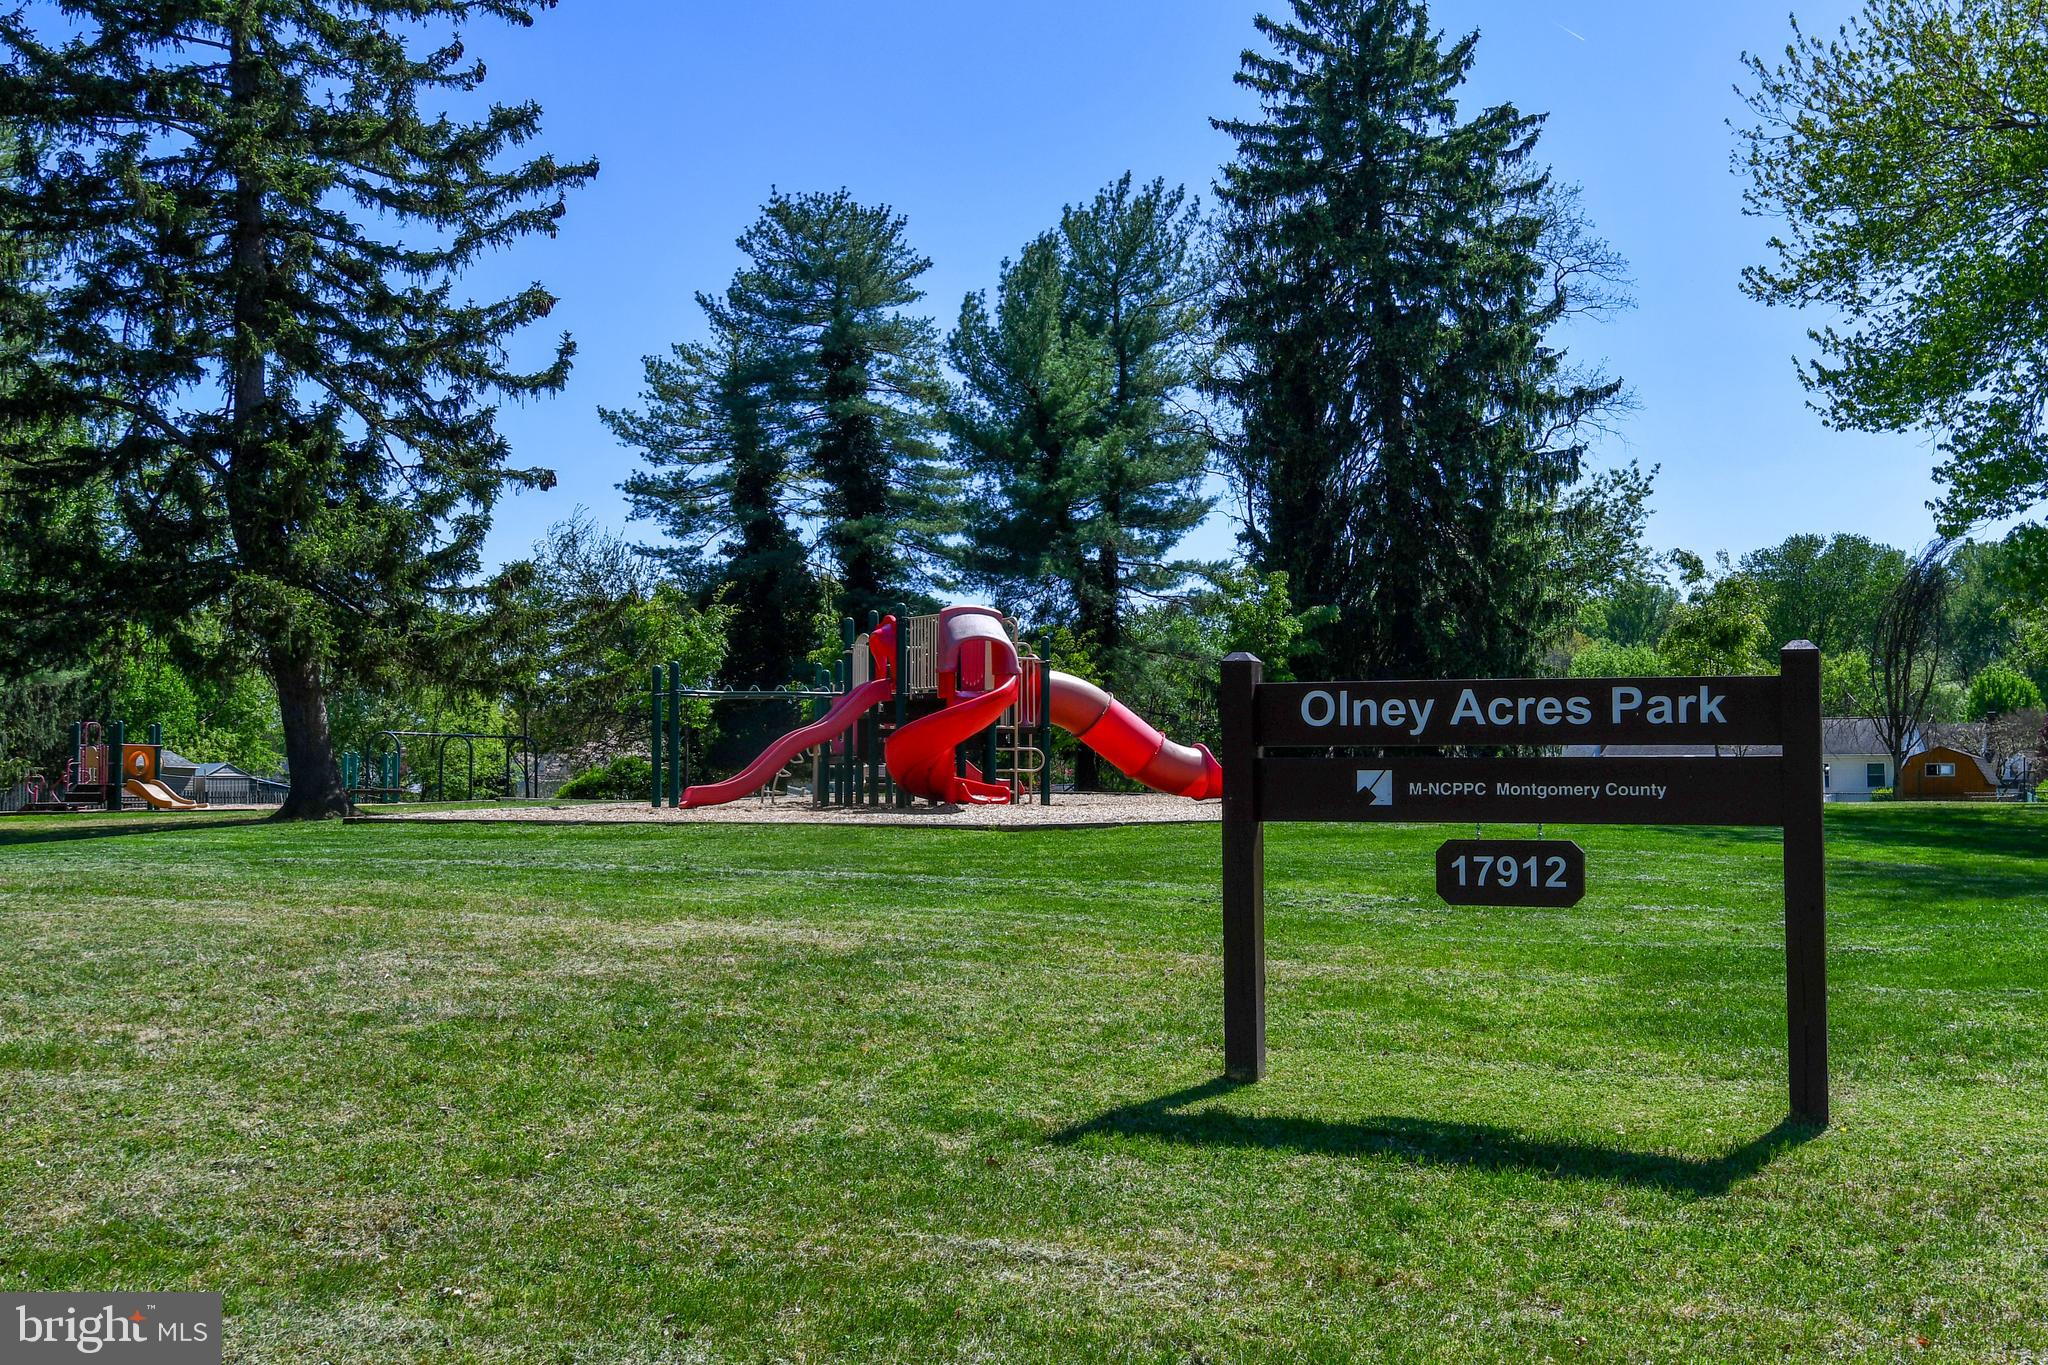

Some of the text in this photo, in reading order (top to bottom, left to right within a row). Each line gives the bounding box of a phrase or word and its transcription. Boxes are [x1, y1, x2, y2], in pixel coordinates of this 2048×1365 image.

[1300, 685, 1727, 736] Olney Acres Park
[1409, 782, 1667, 800] M-NCPPC Montgomery County
[1451, 855, 1567, 888] 17912
